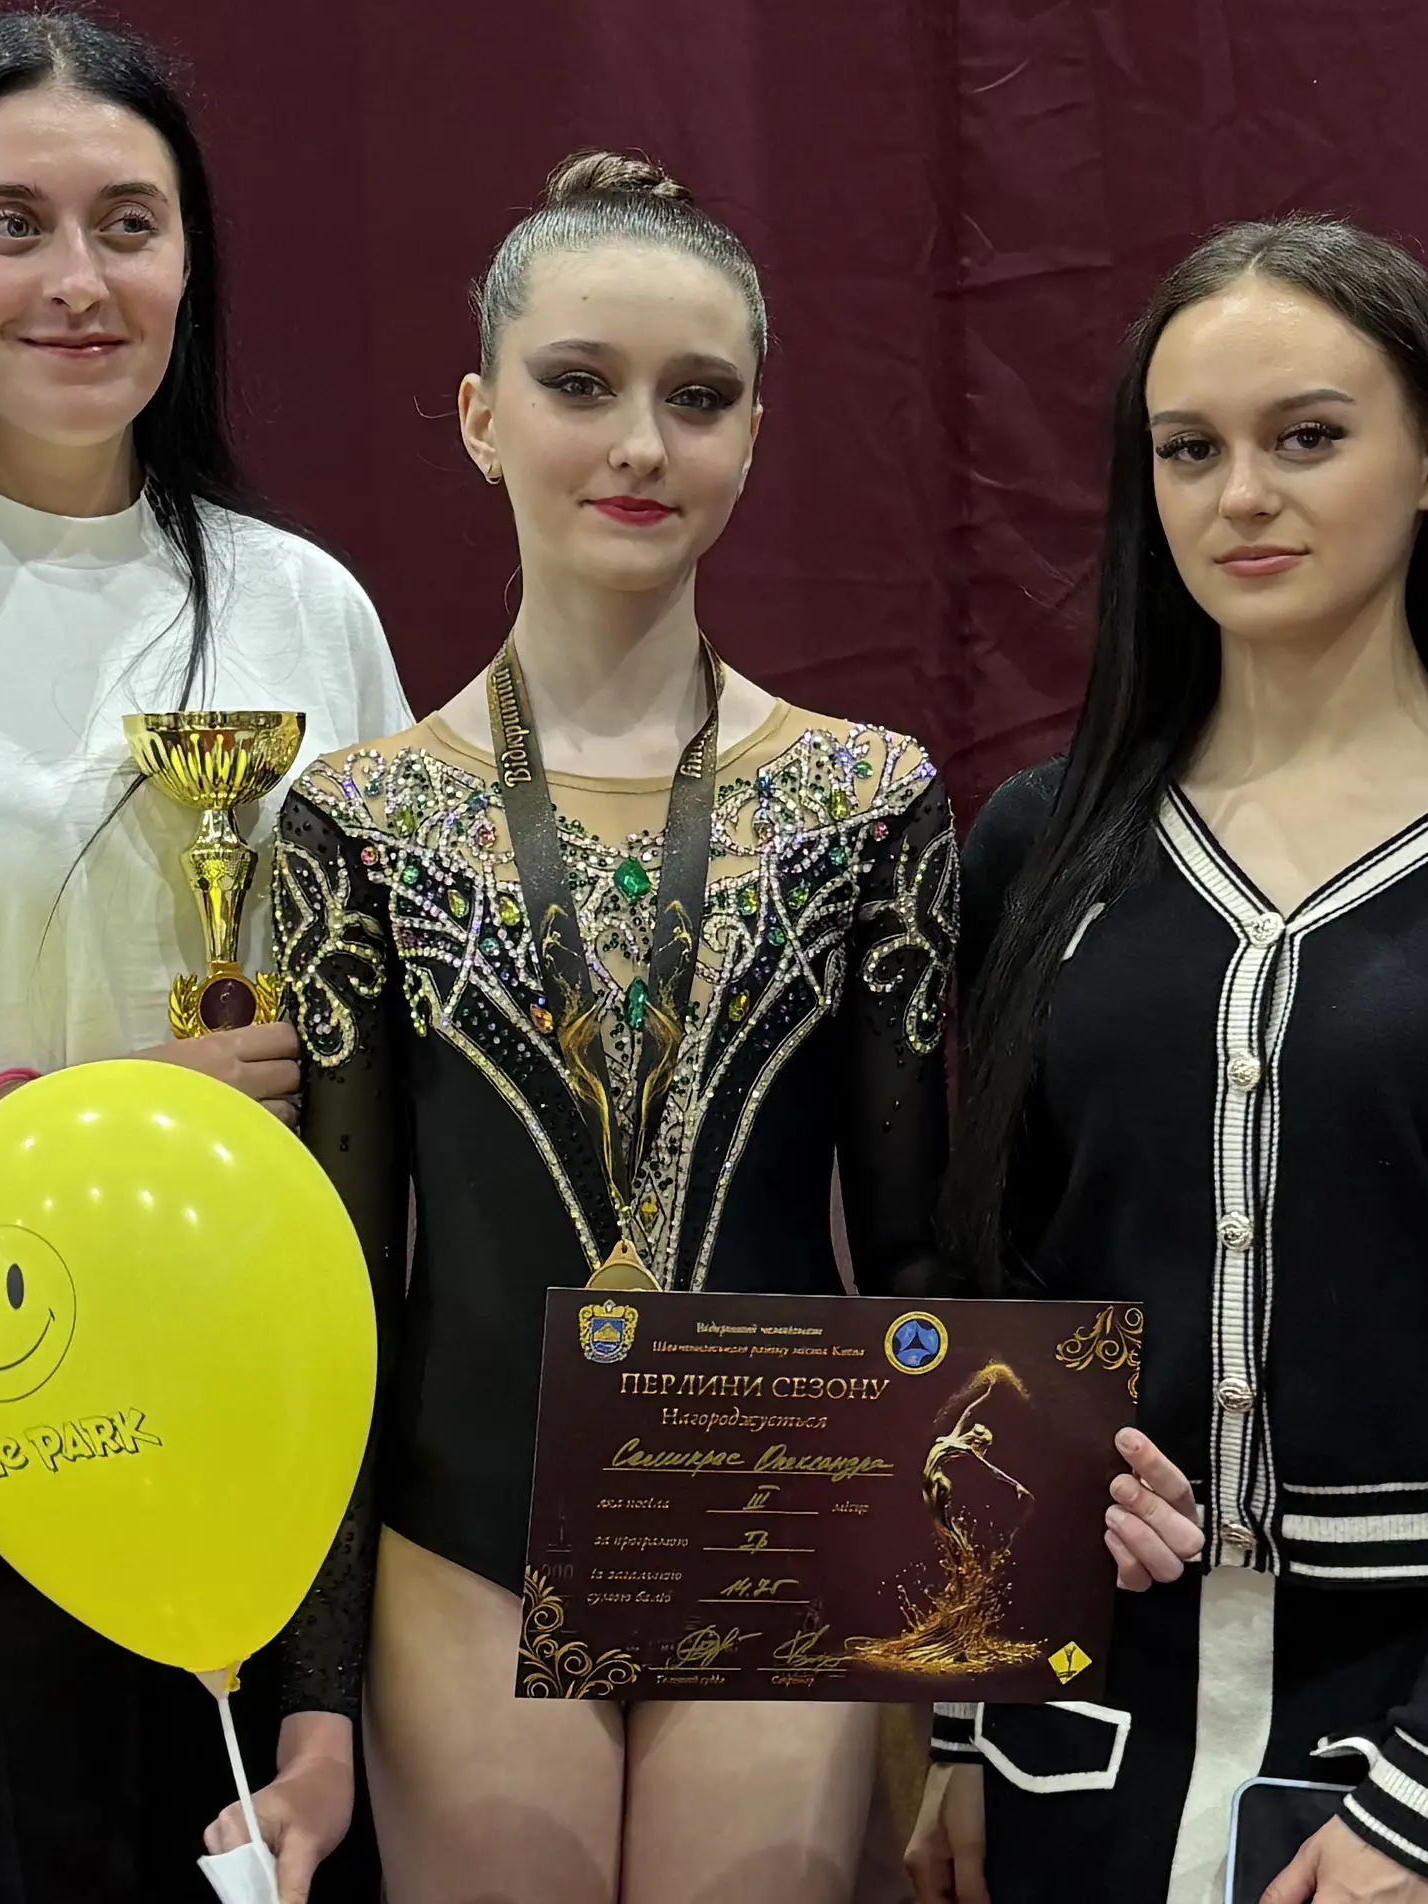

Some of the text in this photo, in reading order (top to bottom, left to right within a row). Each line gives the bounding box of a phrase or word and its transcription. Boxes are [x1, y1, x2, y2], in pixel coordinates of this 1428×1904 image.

[621, 1372, 890, 1400] ПЕРЛИНИ СЕЗОНУ
[661, 1406, 828, 1432] Нагороджується
[23, 1407, 164, 1474] PARK
